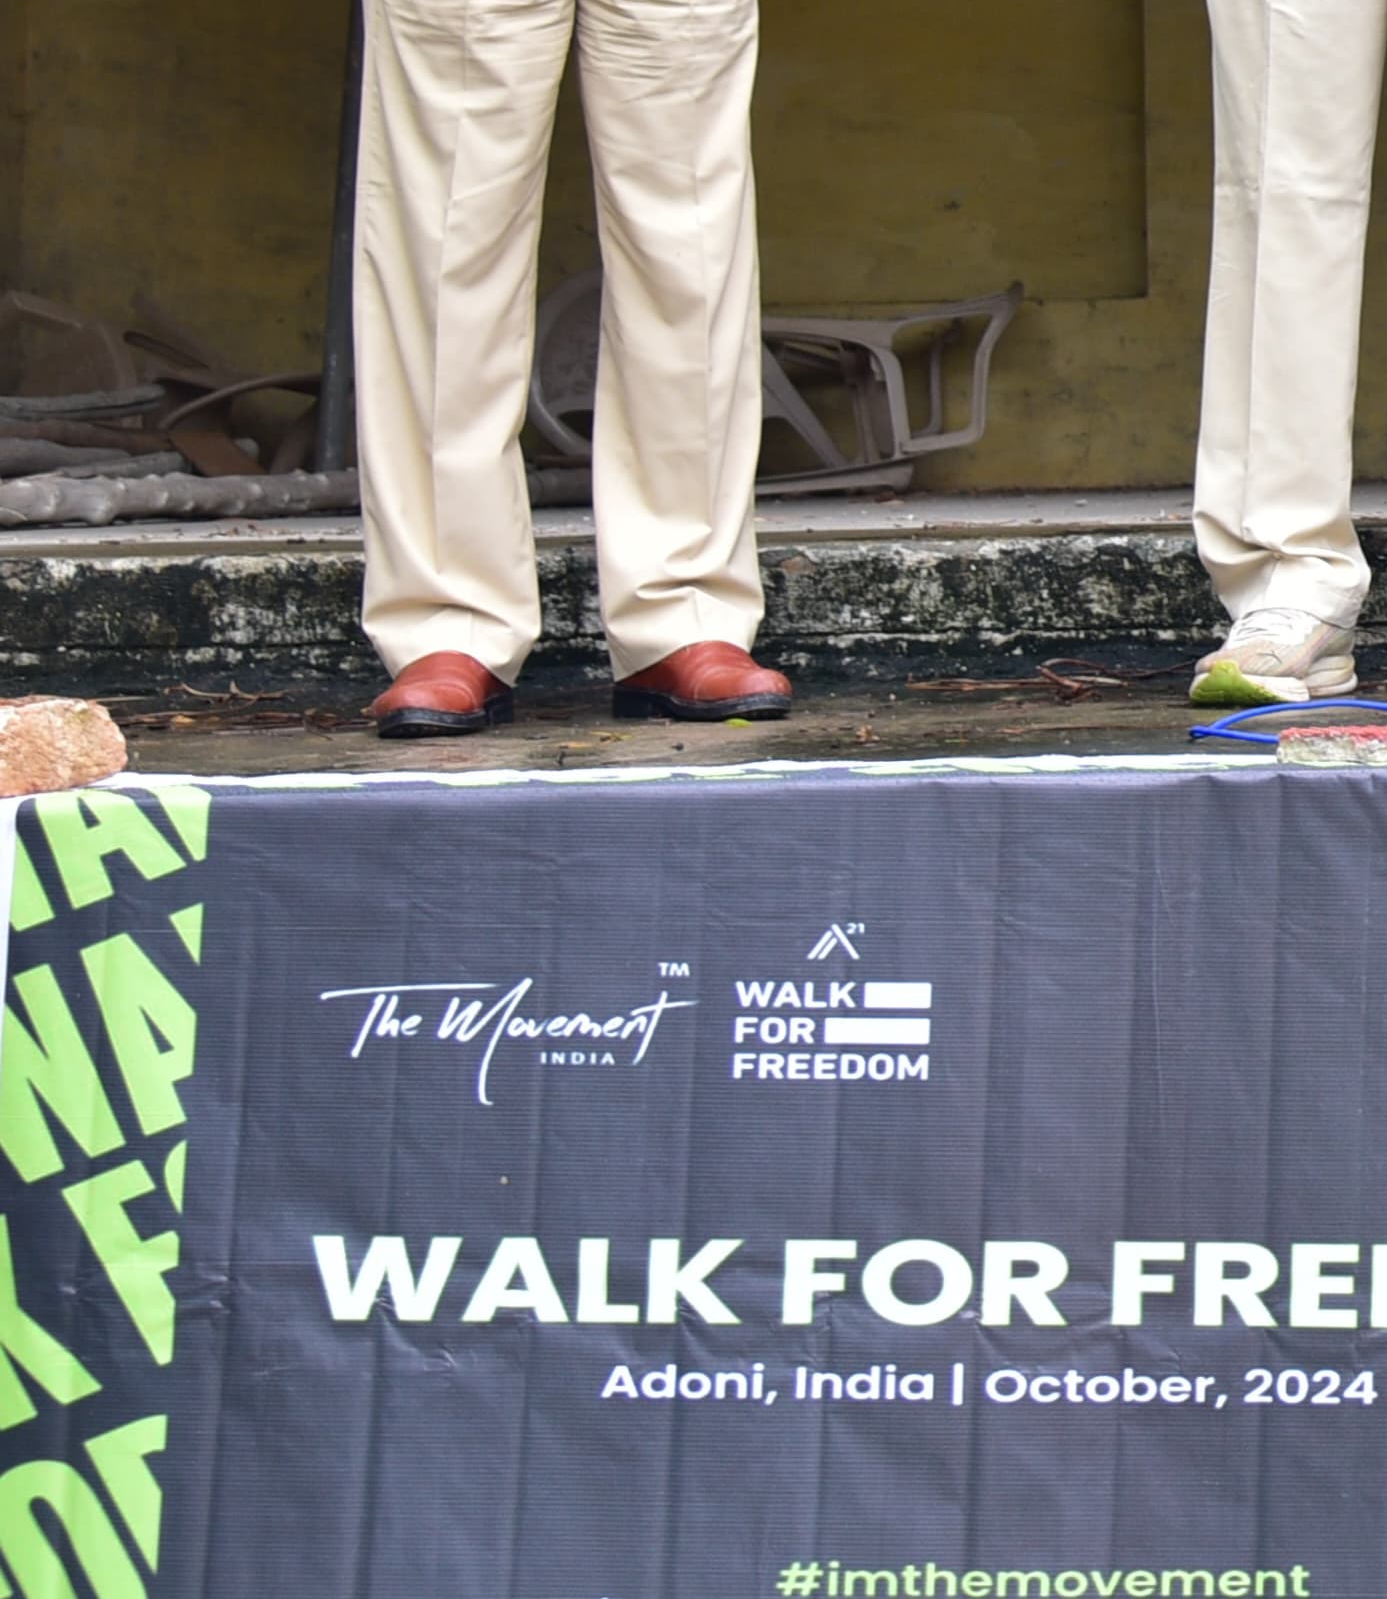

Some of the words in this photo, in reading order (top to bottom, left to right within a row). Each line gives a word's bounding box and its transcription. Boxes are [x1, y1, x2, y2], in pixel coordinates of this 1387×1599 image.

[735, 980, 857, 1009] WALK
[437, 977, 699, 1106] Movement
[734, 1016, 816, 1045] FOR
[539, 1051, 615, 1066] INDIA
[732, 1052, 930, 1081] FREEDOM
[311, 1234, 743, 1325] WALK
[780, 1238, 1070, 1327] FOR
[601, 1362, 778, 1406] Adoni,
[794, 1364, 935, 1401] India
[984, 1366, 1228, 1410] October,
[1243, 1368, 1379, 1405] 2024
[775, 1560, 1310, 1598] #imthemovement
